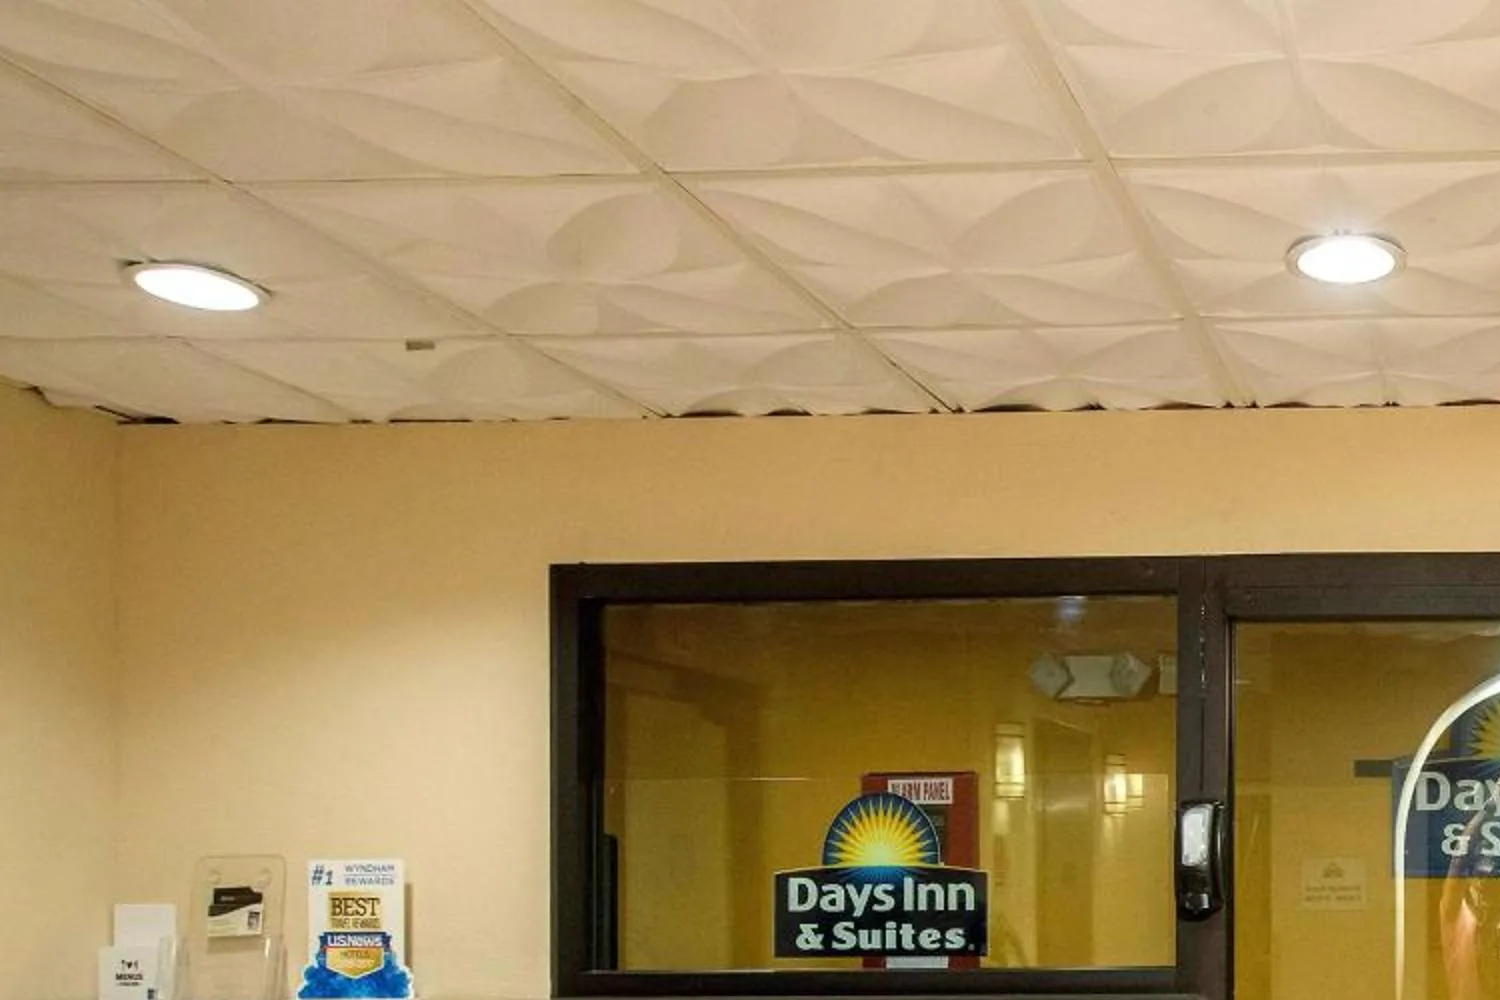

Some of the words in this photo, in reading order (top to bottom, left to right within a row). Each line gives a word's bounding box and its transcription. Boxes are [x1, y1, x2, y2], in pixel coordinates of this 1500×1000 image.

[924, 781, 950, 800] PANEL
[311, 864, 333, 886] #1
[331, 897, 381, 917] BEST
[787, 877, 895, 917] Days
[903, 877, 975, 911] Inn
[795, 923, 824, 950] &
